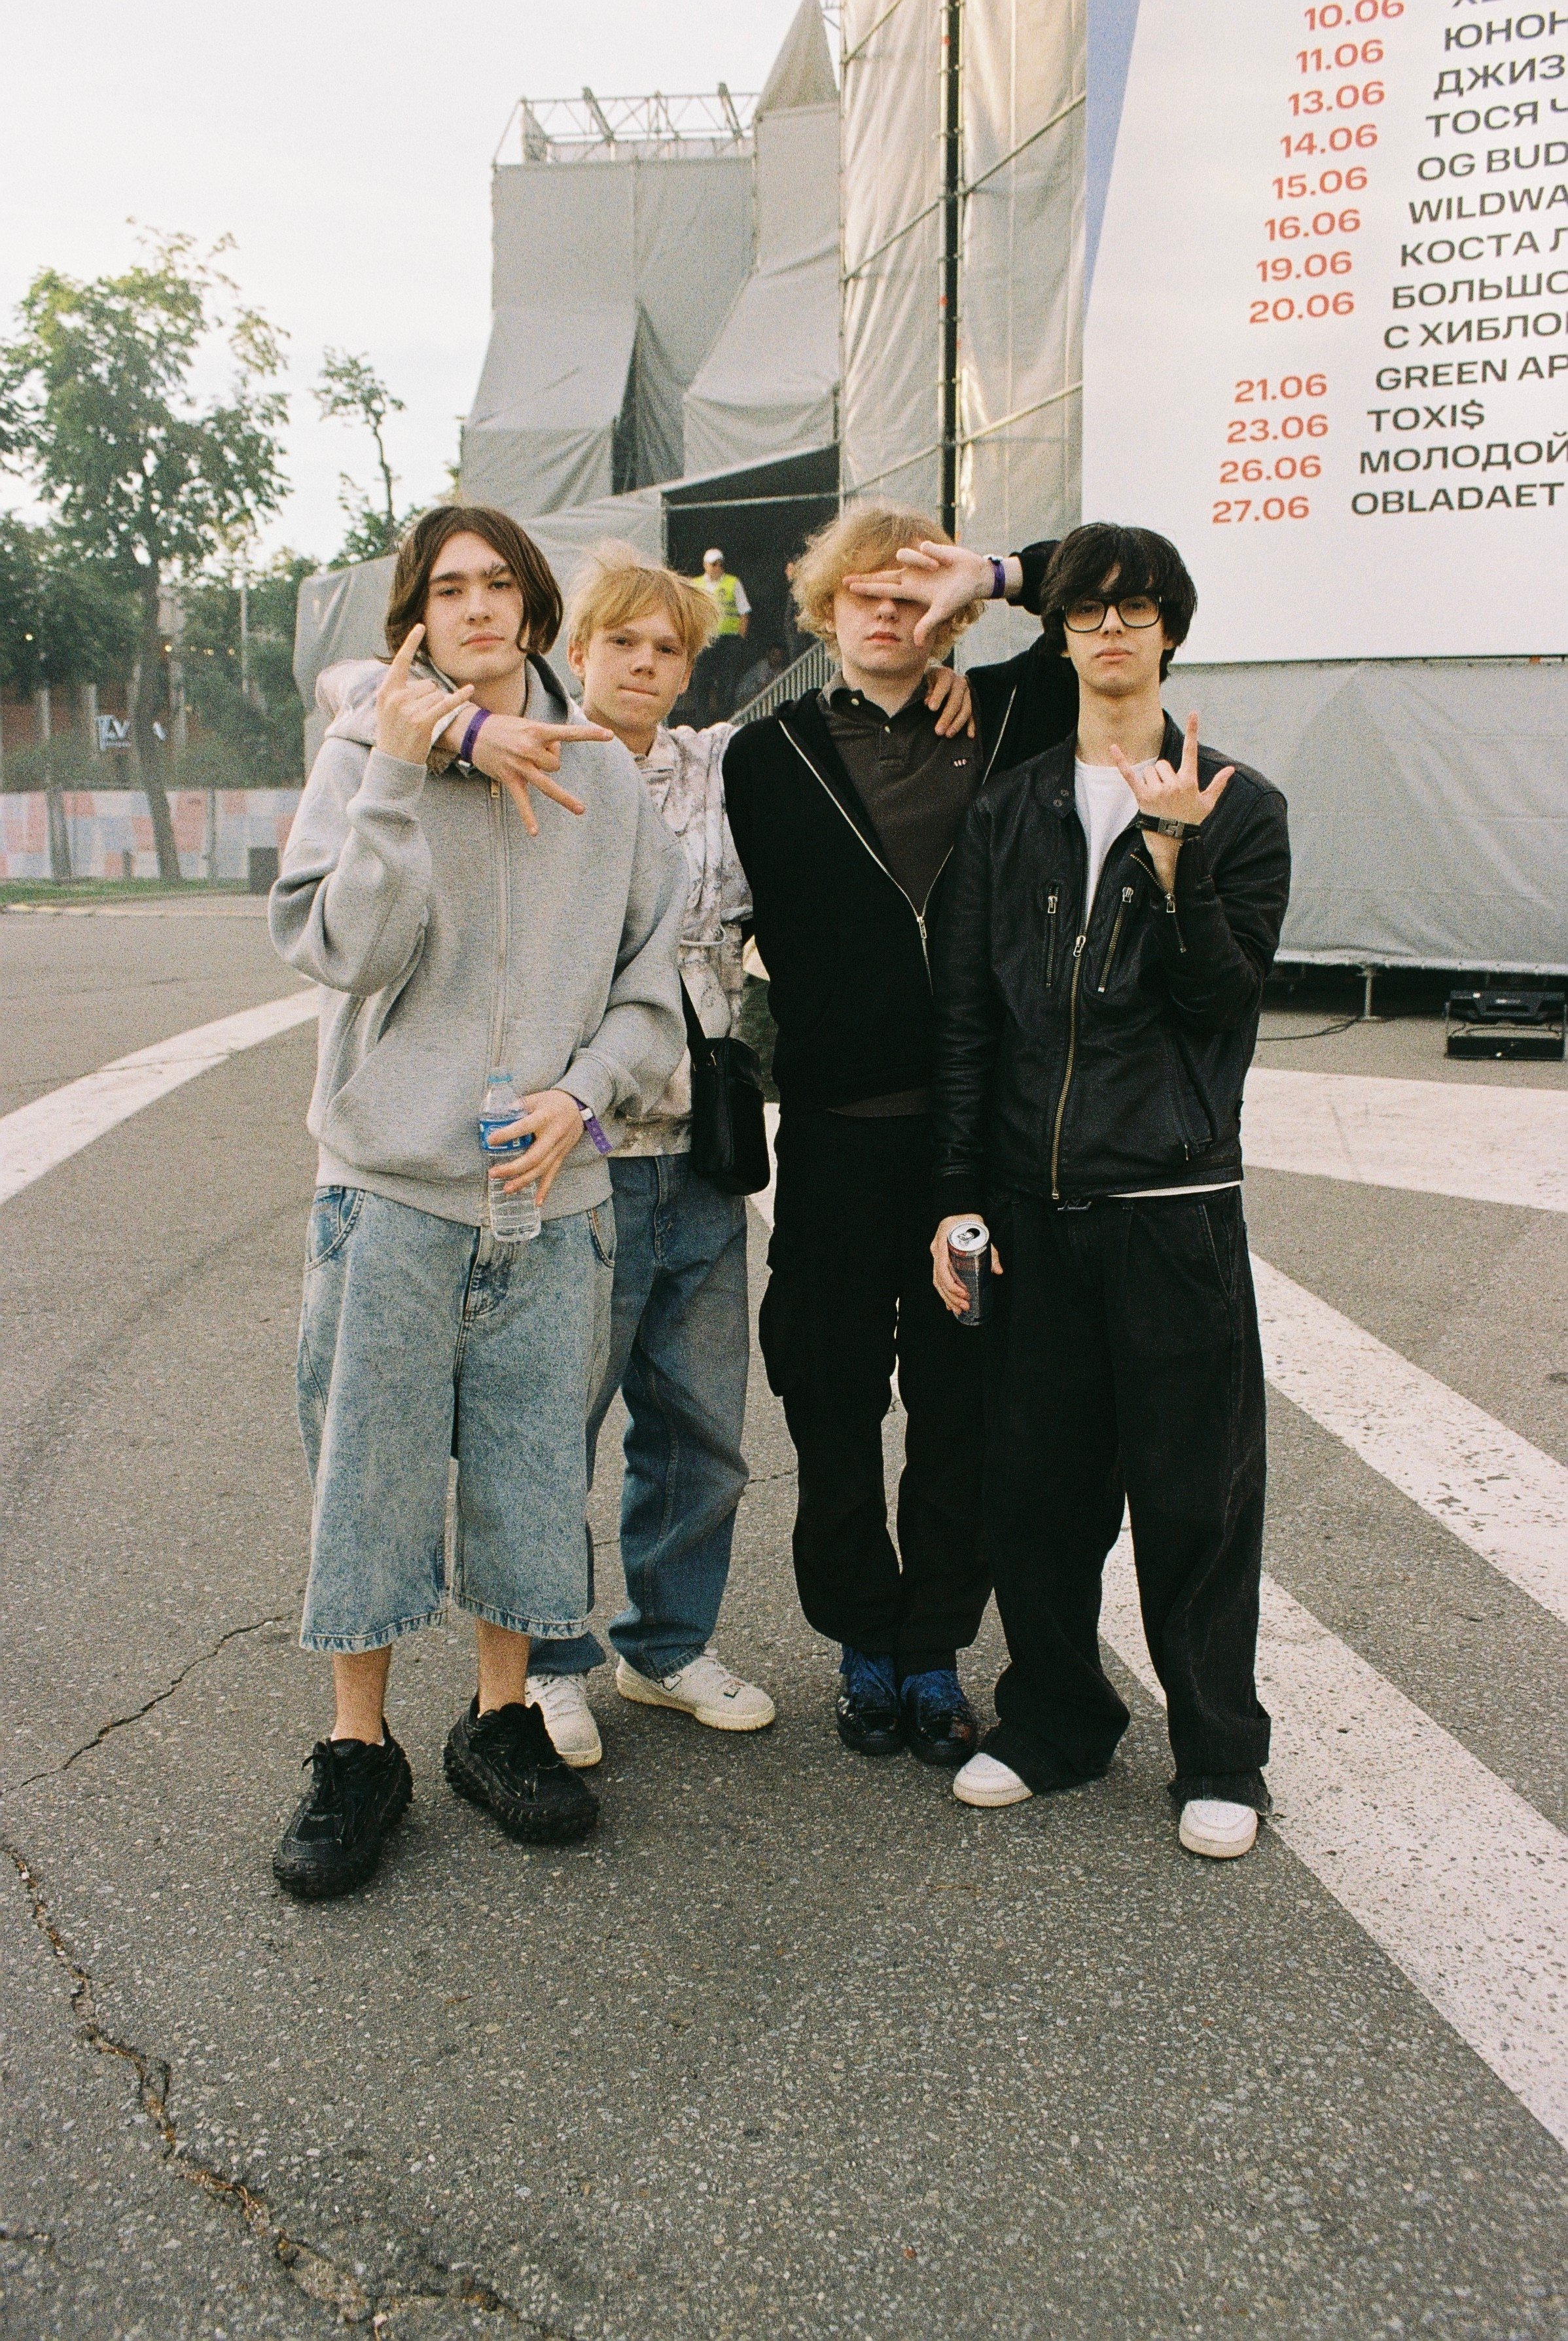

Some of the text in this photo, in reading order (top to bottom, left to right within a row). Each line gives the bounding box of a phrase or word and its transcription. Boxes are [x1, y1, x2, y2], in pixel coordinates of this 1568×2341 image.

[1305, 0, 1404, 30] 10.06
[1297, 39, 1383, 73] 11.06
[1289, 54, 1565, 115] 13.06 ДЖИЗ
[1281, 124, 1378, 158] 14.06
[1425, 101, 1538, 137] ТОСЯ
[1274, 141, 1568, 199] 15.06 OG BUD
[1266, 185, 1568, 241] 16.06 WILDWA
[1258, 251, 1352, 281] 19.06
[1401, 231, 1539, 267] КОСТА
[1250, 270, 1568, 323] 20.06 БОЛЬШО
[1383, 312, 1568, 349] С ХИБЛО
[1235, 374, 1327, 402] 21.06
[1376, 359, 1506, 391] GREEN
[1227, 399, 1485, 443] 23.06 TOXI$
[1220, 431, 1568, 483] 26.06 МОЛОДОЙ
[1213, 482, 1565, 523] 27.06 OBLADAET
